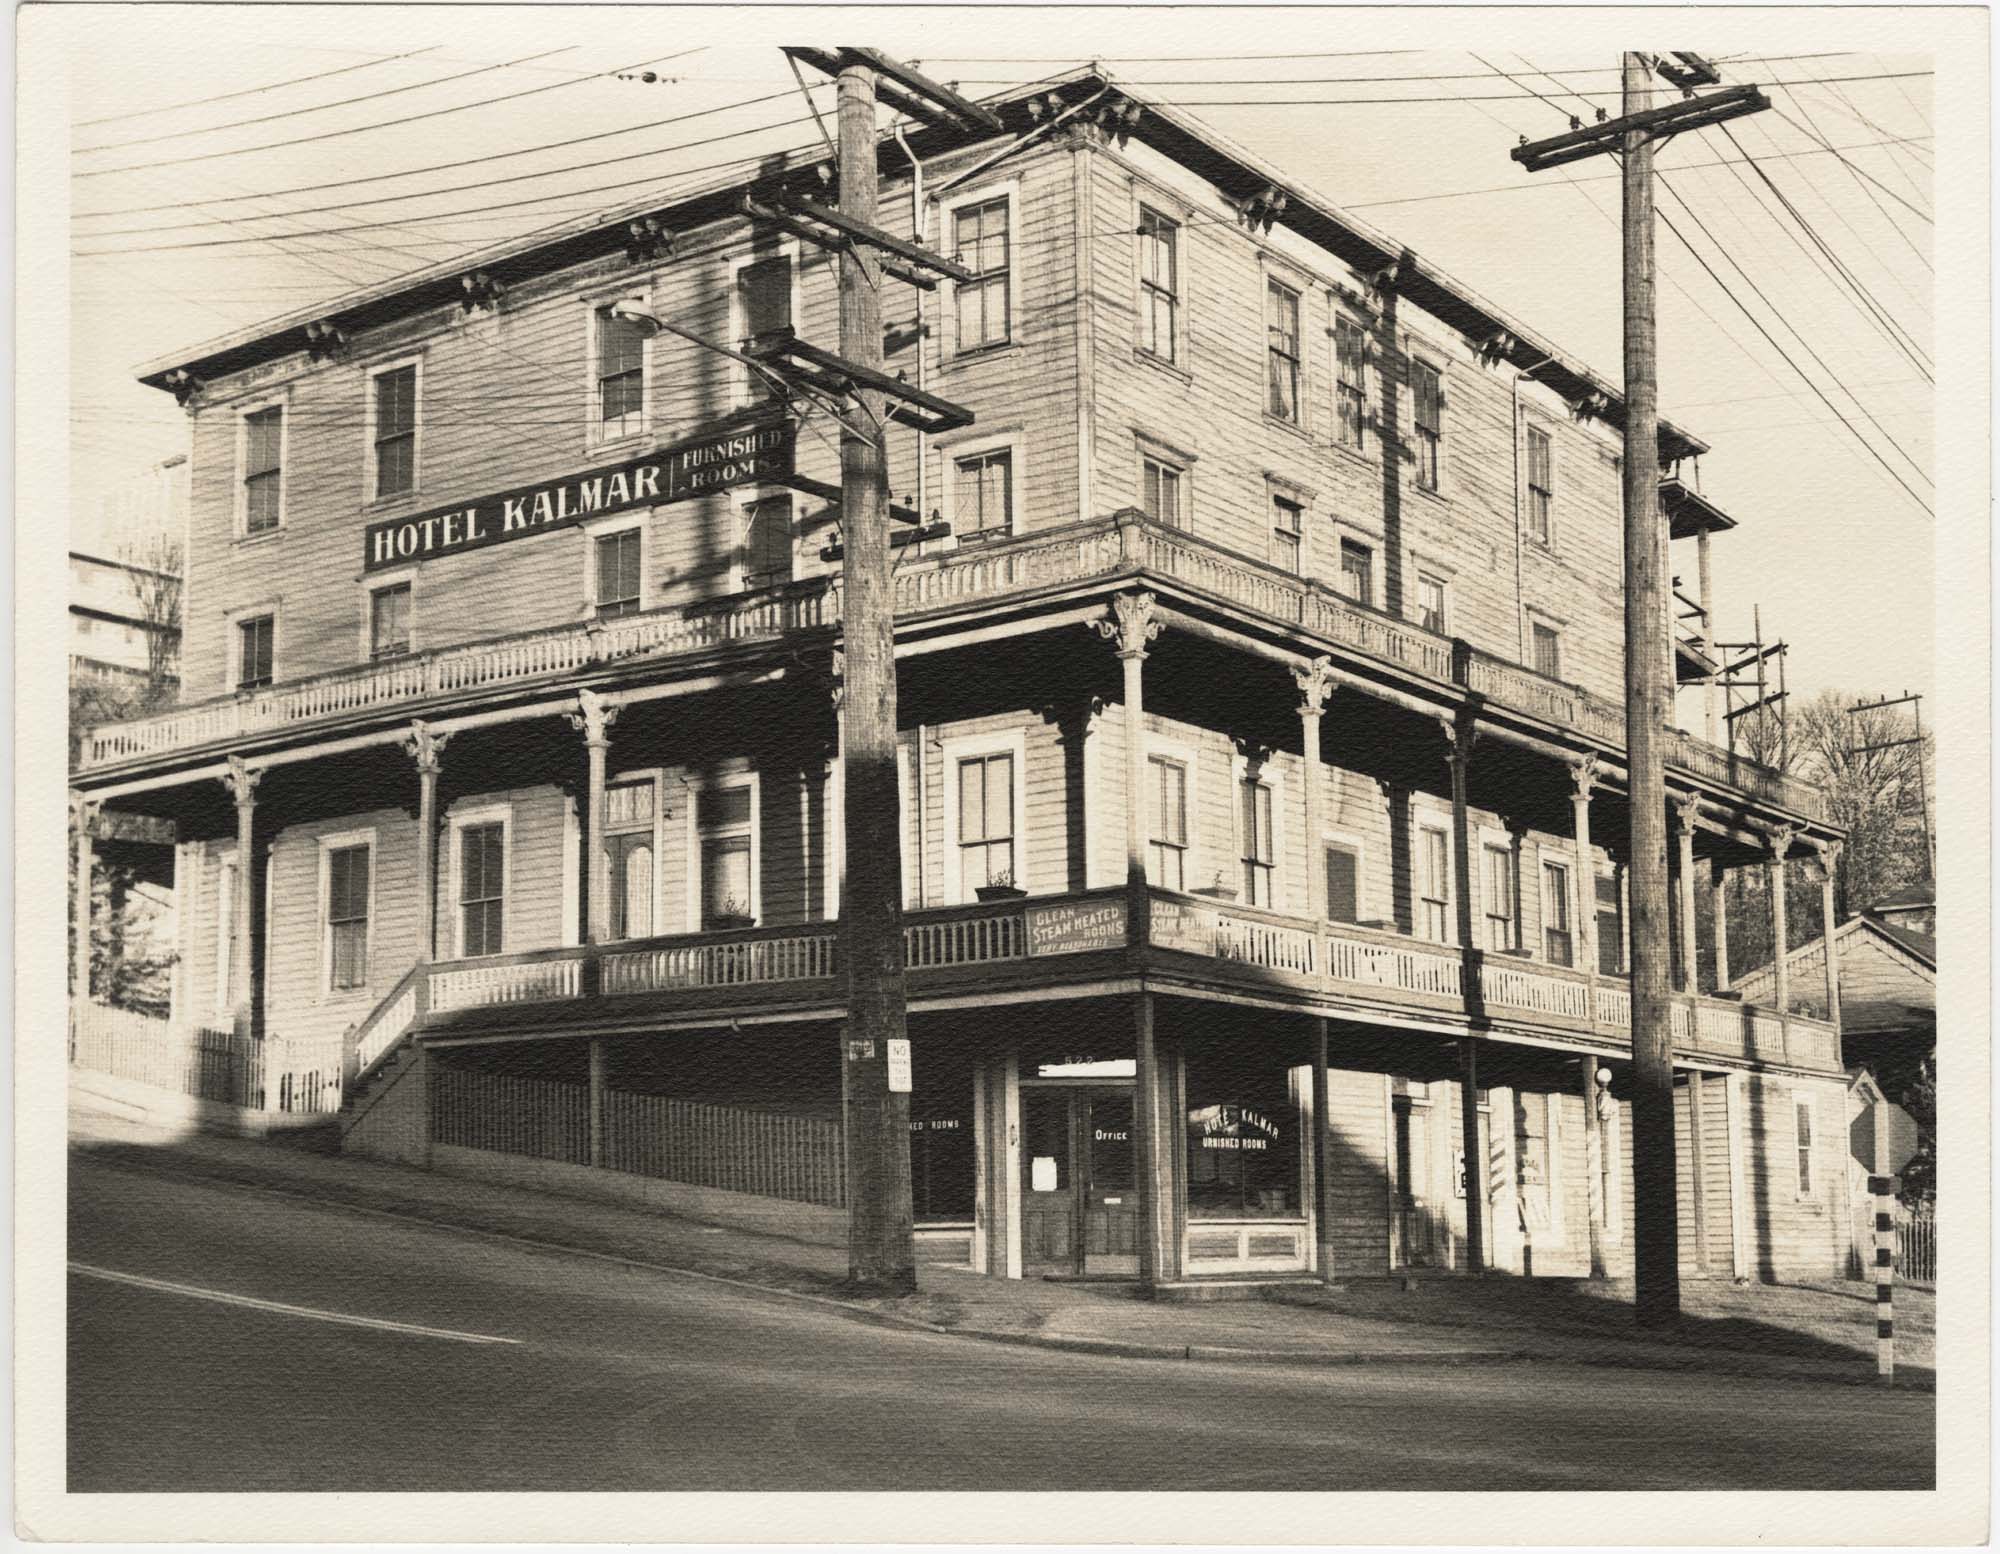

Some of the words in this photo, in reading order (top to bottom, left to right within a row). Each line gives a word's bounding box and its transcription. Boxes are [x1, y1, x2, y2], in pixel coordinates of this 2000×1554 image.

[683, 430, 781, 469] FURNISHED
[691, 459, 770, 488] ROOM
[374, 508, 486, 562] HOTEL
[503, 465, 661, 532] KALMAR
[1033, 921, 1071, 944] STEAM
[1074, 906, 1119, 931] HEATED
[1036, 908, 1074, 926] CLEAN
[1083, 920, 1124, 939] ROOMS
[1204, 1107, 1231, 1136] HOTE
[1241, 1108, 1279, 1140] KALMAR
[1242, 1138, 1267, 1150] ROOMS
